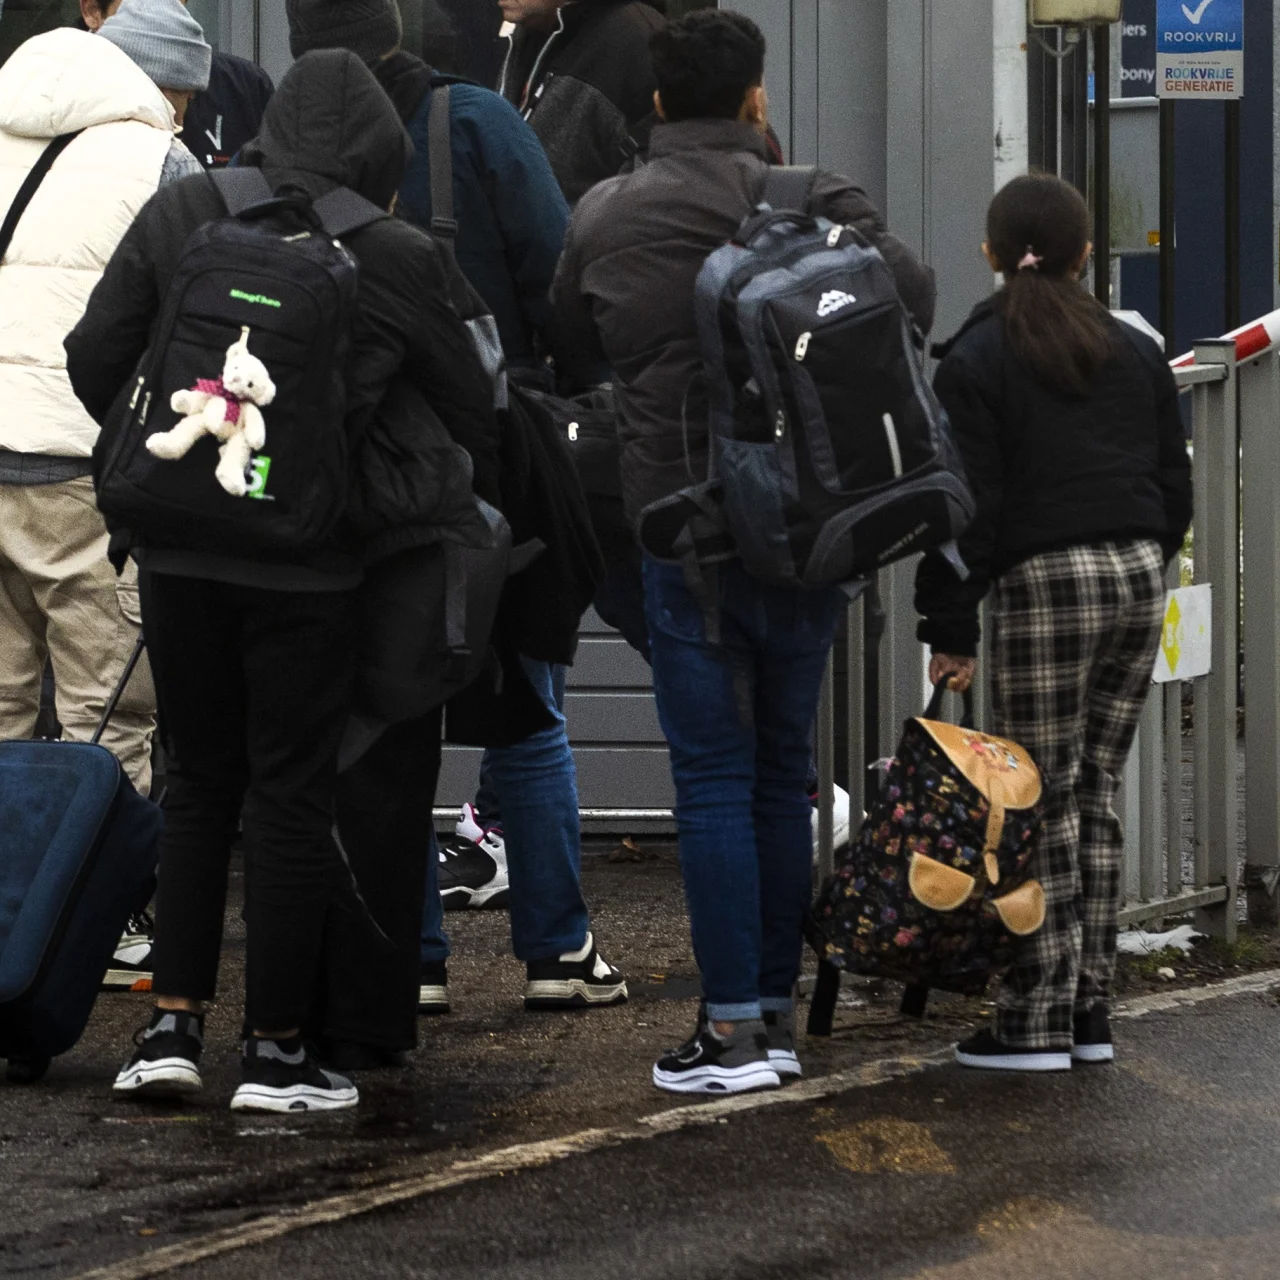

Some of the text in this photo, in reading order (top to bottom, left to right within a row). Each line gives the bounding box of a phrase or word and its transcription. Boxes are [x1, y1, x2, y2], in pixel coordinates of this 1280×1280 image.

[1164, 31, 1237, 43] ROOKVRIJ
[1165, 67, 1235, 80] ROOKVRIJE
[1165, 80, 1235, 93] GENERATIE
